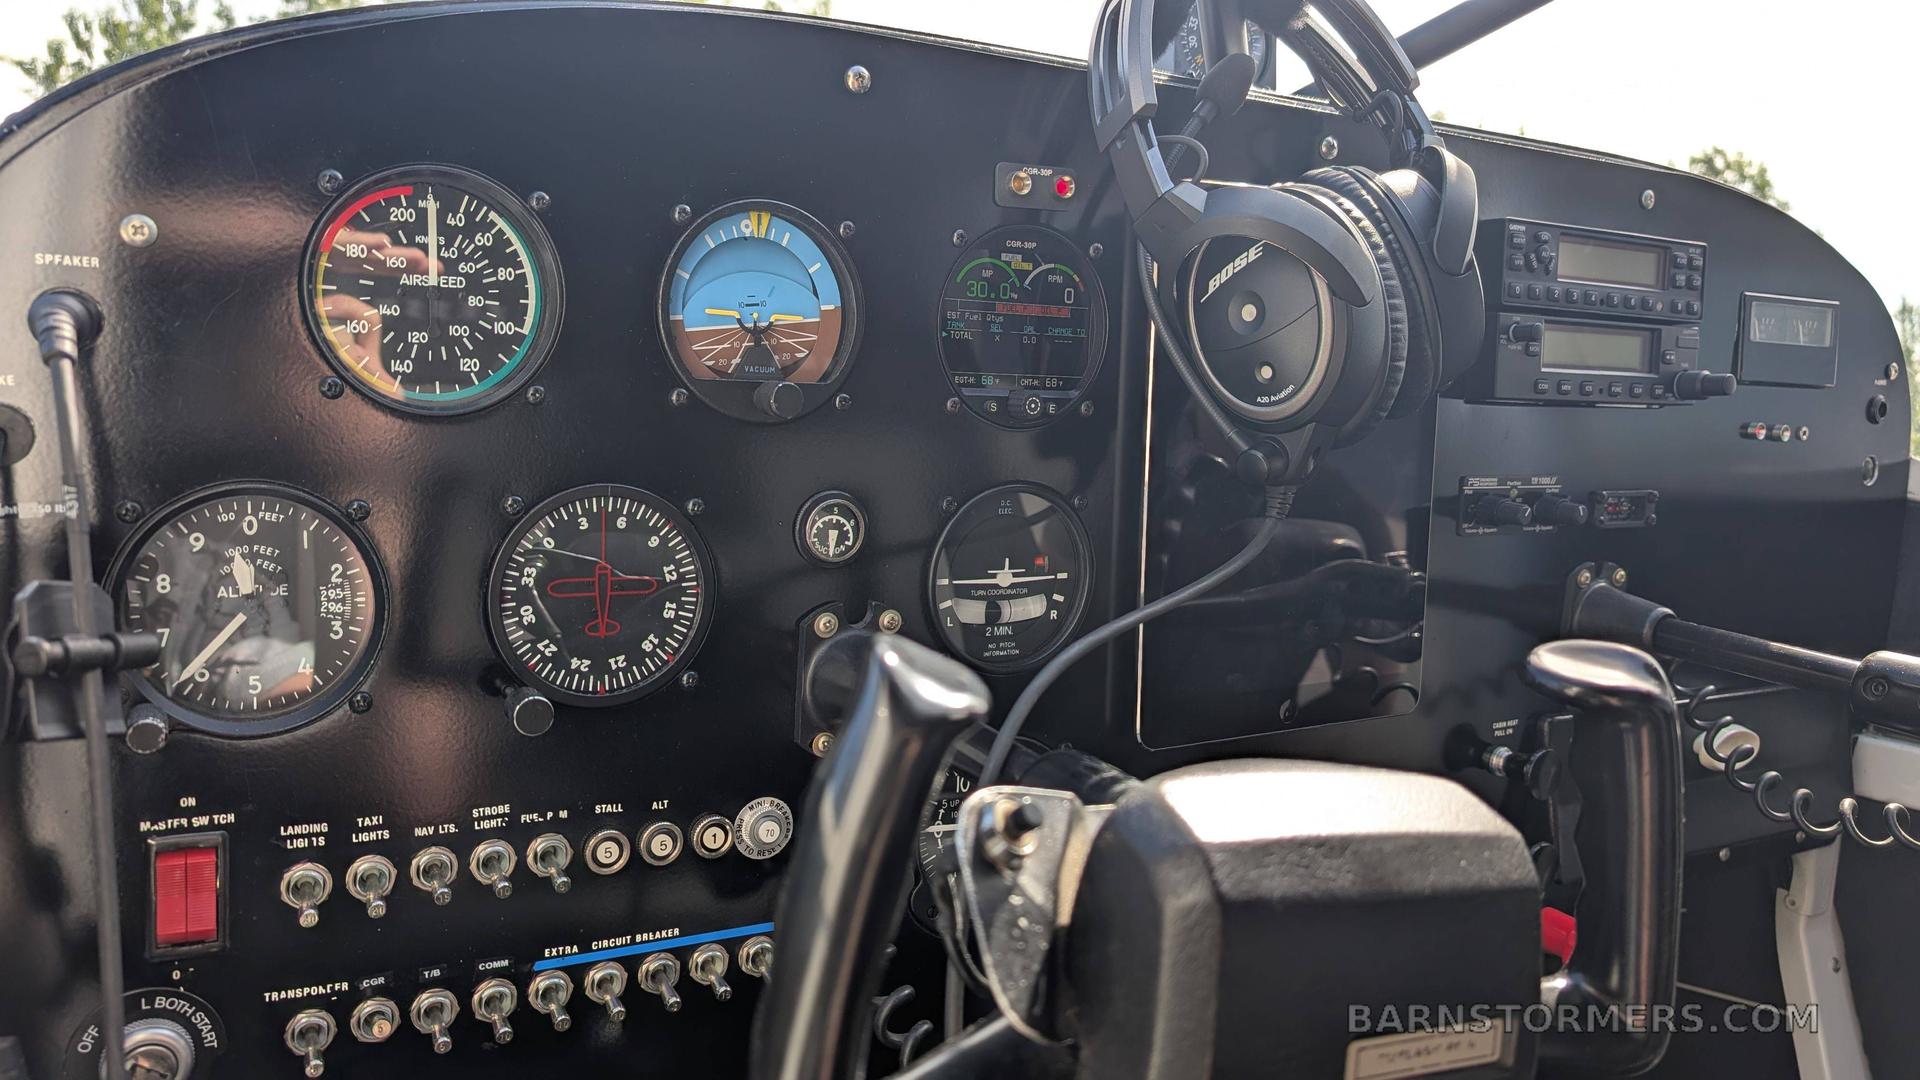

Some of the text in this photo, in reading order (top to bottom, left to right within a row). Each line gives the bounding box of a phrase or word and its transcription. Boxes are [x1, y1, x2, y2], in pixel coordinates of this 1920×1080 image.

[1189, 18, 1198, 30] 33
[1188, 36, 1198, 48] 30
[1022, 167, 1052, 176] CGR-30P
[390, 208, 416, 222] 200
[446, 212, 465, 227] 40
[415, 235, 446, 245] KNS
[474, 232, 492, 246] 60
[1006, 240, 1037, 249] CGR-30P
[346, 244, 368, 258] 180
[440, 246, 458, 258] 40
[386, 257, 406, 268] 160
[458, 262, 476, 273] 60
[497, 267, 515, 280] 80
[982, 270, 994, 278] MP
[1048, 274, 1062, 284] RPM
[1200, 246, 1264, 303] BOSE
[400, 273, 466, 288] AIRSEED
[966, 280, 1010, 299] 30.0
[1064, 288, 1074, 304] 0
[1554, 290, 1559, 298] 2
[468, 296, 484, 307] 80
[379, 304, 400, 316] 140
[986, 314, 1004, 322] Qtys
[346, 320, 368, 334] 160
[449, 325, 470, 337] 100
[494, 322, 515, 335] 100
[947, 321, 964, 329] TANK
[1048, 327, 1072, 335] CHANGE
[408, 331, 428, 343] 120
[950, 331, 974, 340] TOTAL
[390, 360, 412, 374] 140
[460, 358, 480, 372] 120
[744, 365, 776, 374] VACUUM
[1270, 384, 1295, 402] Aviation
[990, 402, 997, 412] S
[1049, 404, 1056, 414] E
[217, 511, 284, 522] 100 FEET
[616, 516, 626, 529] 6
[242, 515, 258, 536] 0
[578, 517, 588, 530] 3
[190, 532, 205, 552] 9
[303, 530, 309, 549] 1
[543, 537, 556, 549] 0
[648, 536, 660, 548] 9
[224, 544, 280, 558] 1000 FEET
[814, 542, 845, 554] SUCON
[220, 558, 282, 576] 100 FEET
[331, 563, 343, 583] 2
[662, 564, 678, 582] 12
[522, 566, 537, 588] 33
[156, 574, 171, 594] 8
[217, 584, 288, 598] ALTTDE
[320, 588, 344, 601] 29.5
[320, 602, 344, 612] 29.6
[663, 601, 677, 620] 15
[520, 605, 536, 626] 30
[947, 617, 953, 626] L
[1050, 610, 1058, 620] R
[330, 620, 344, 640] 3
[986, 625, 1014, 636] 2 MIN.
[156, 628, 170, 647] 7
[641, 633, 660, 652] 18
[536, 638, 558, 656] 27
[297, 656, 314, 676] 4
[570, 656, 592, 672] 24
[608, 654, 627, 670] 21
[248, 675, 262, 694] 5
[180, 797, 196, 808] ON
[594, 804, 624, 814] STALL
[652, 800, 669, 810] ALT
[942, 800, 948, 808] 5
[472, 804, 510, 818] STROBE
[192, 813, 235, 827] SWTCH
[356, 815, 383, 828] TAXI
[280, 822, 328, 836] LANDING
[414, 824, 458, 836] NAV LTS.
[766, 828, 774, 838] 70
[352, 830, 390, 843] LIGHTS
[711, 833, 717, 844] 1
[736, 818, 782, 856] PRESS TO RESET
[660, 840, 668, 850] 5
[604, 847, 612, 858] 5
[544, 928, 680, 958] EXTRA CIRCUIT BREAKER
[478, 960, 509, 970] COMM
[423, 968, 441, 979] T/B
[362, 976, 385, 987] CGR
[141, 996, 218, 1048] L BOTH START
[377, 1024, 384, 1033] 5
[77, 1024, 100, 1053] OFF
